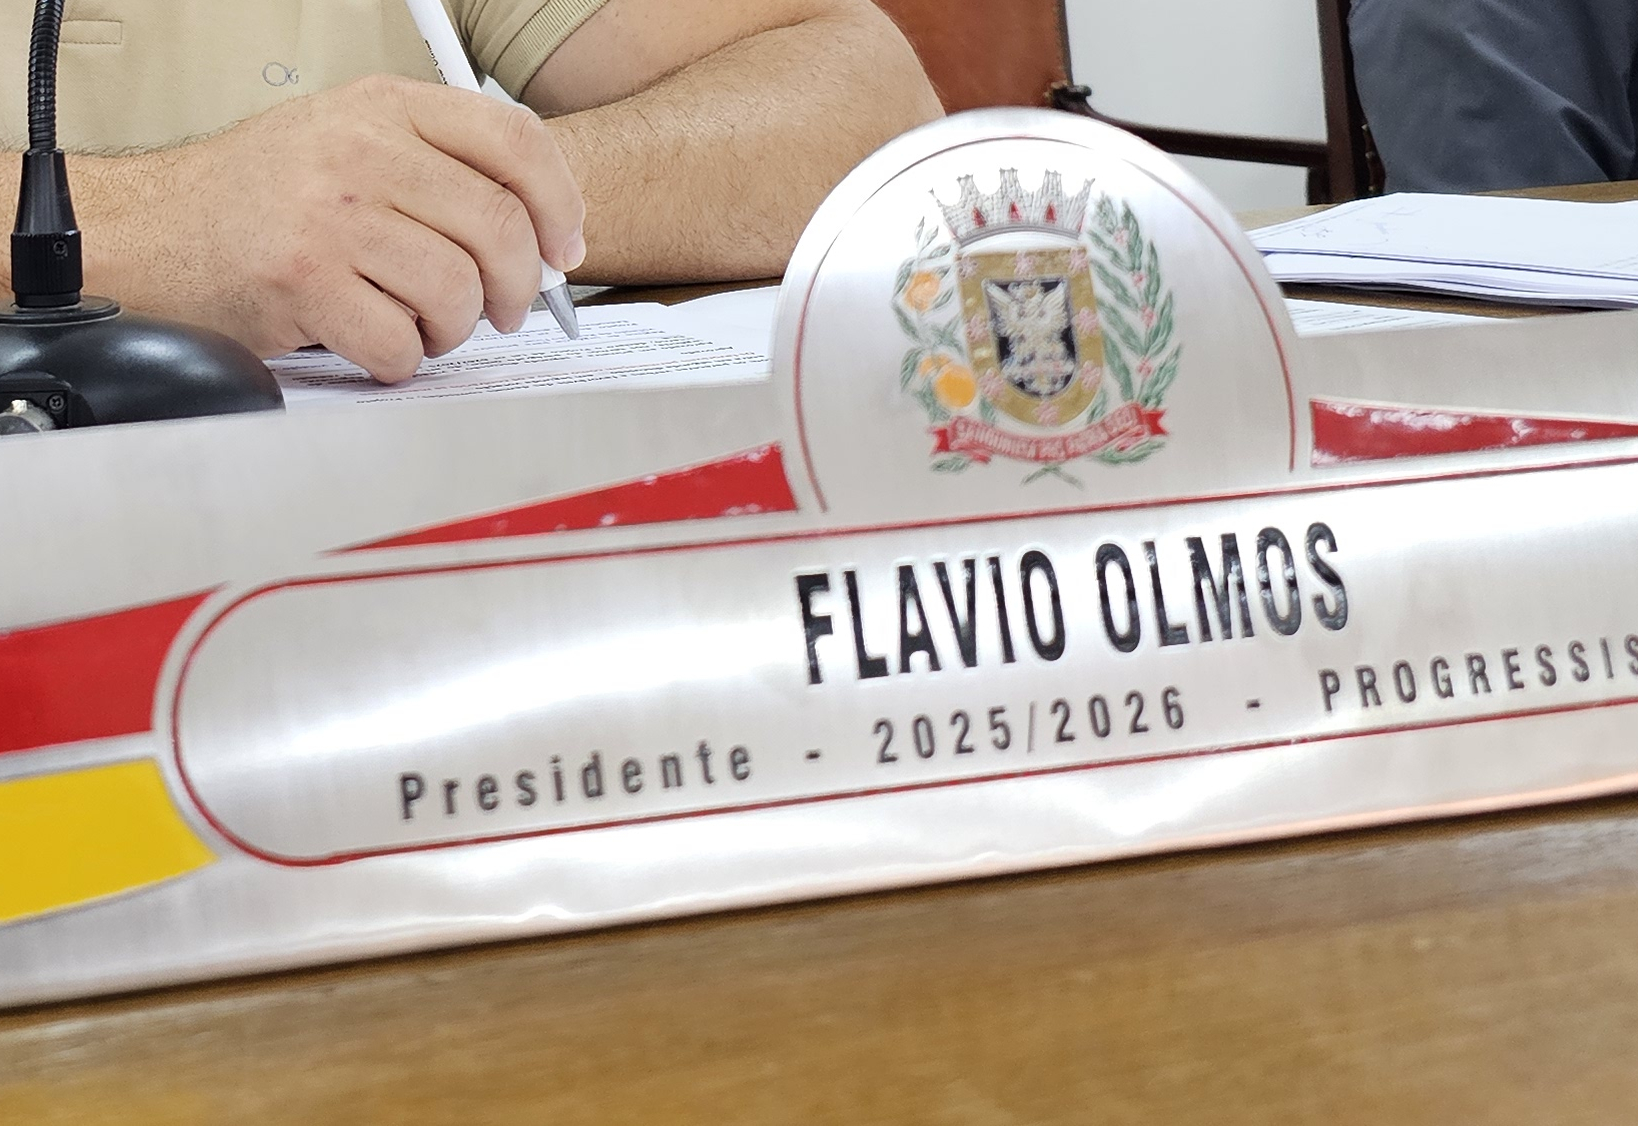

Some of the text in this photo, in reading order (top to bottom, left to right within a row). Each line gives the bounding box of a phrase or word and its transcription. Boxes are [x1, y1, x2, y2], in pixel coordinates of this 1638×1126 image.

[795, 521, 1349, 684] FLAVIO OLMOS
[399, 740, 753, 820] Presidente
[872, 685, 1186, 765] 2025/2026
